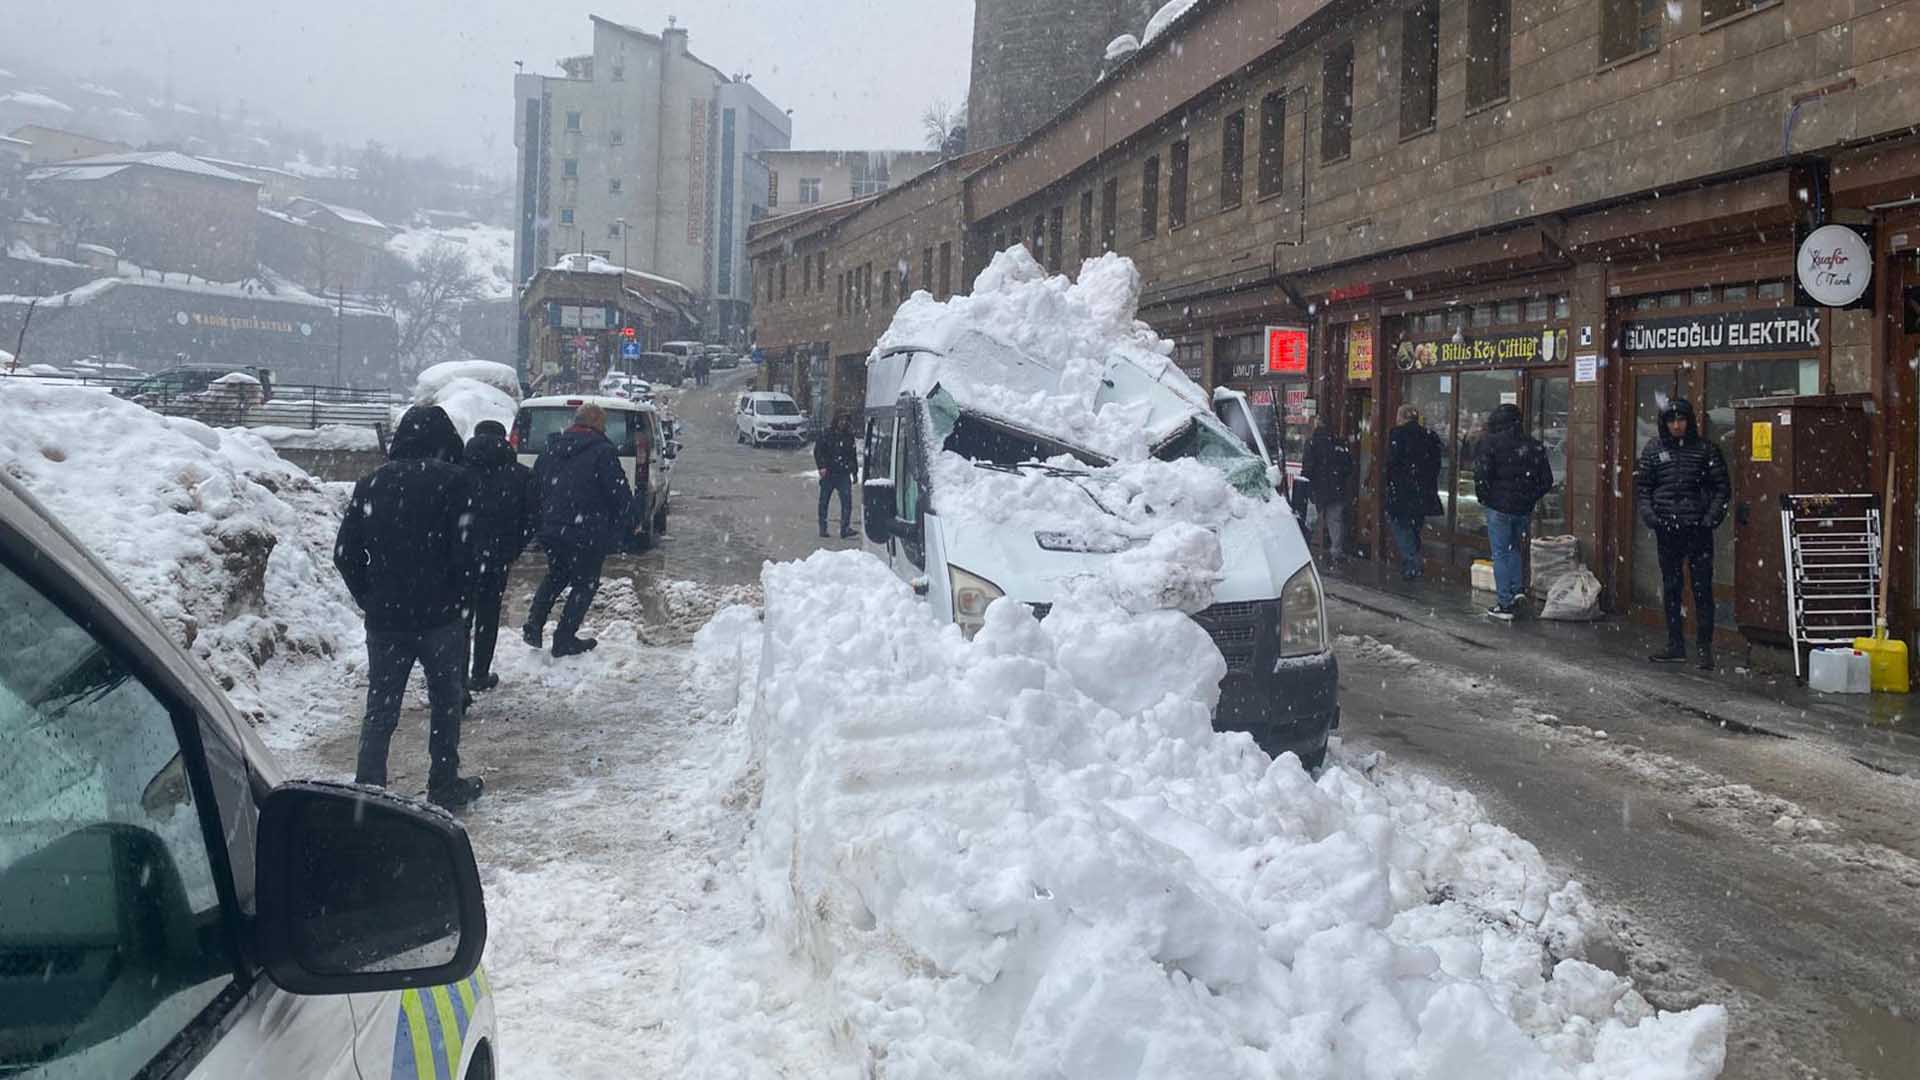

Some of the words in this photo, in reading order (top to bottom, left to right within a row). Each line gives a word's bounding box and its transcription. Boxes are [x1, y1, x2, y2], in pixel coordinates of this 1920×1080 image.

[1473, 340, 1497, 363] Köy
[1497, 336, 1540, 363] Çiftliği
[1625, 321, 1723, 350] GÜNCEOĞLU
